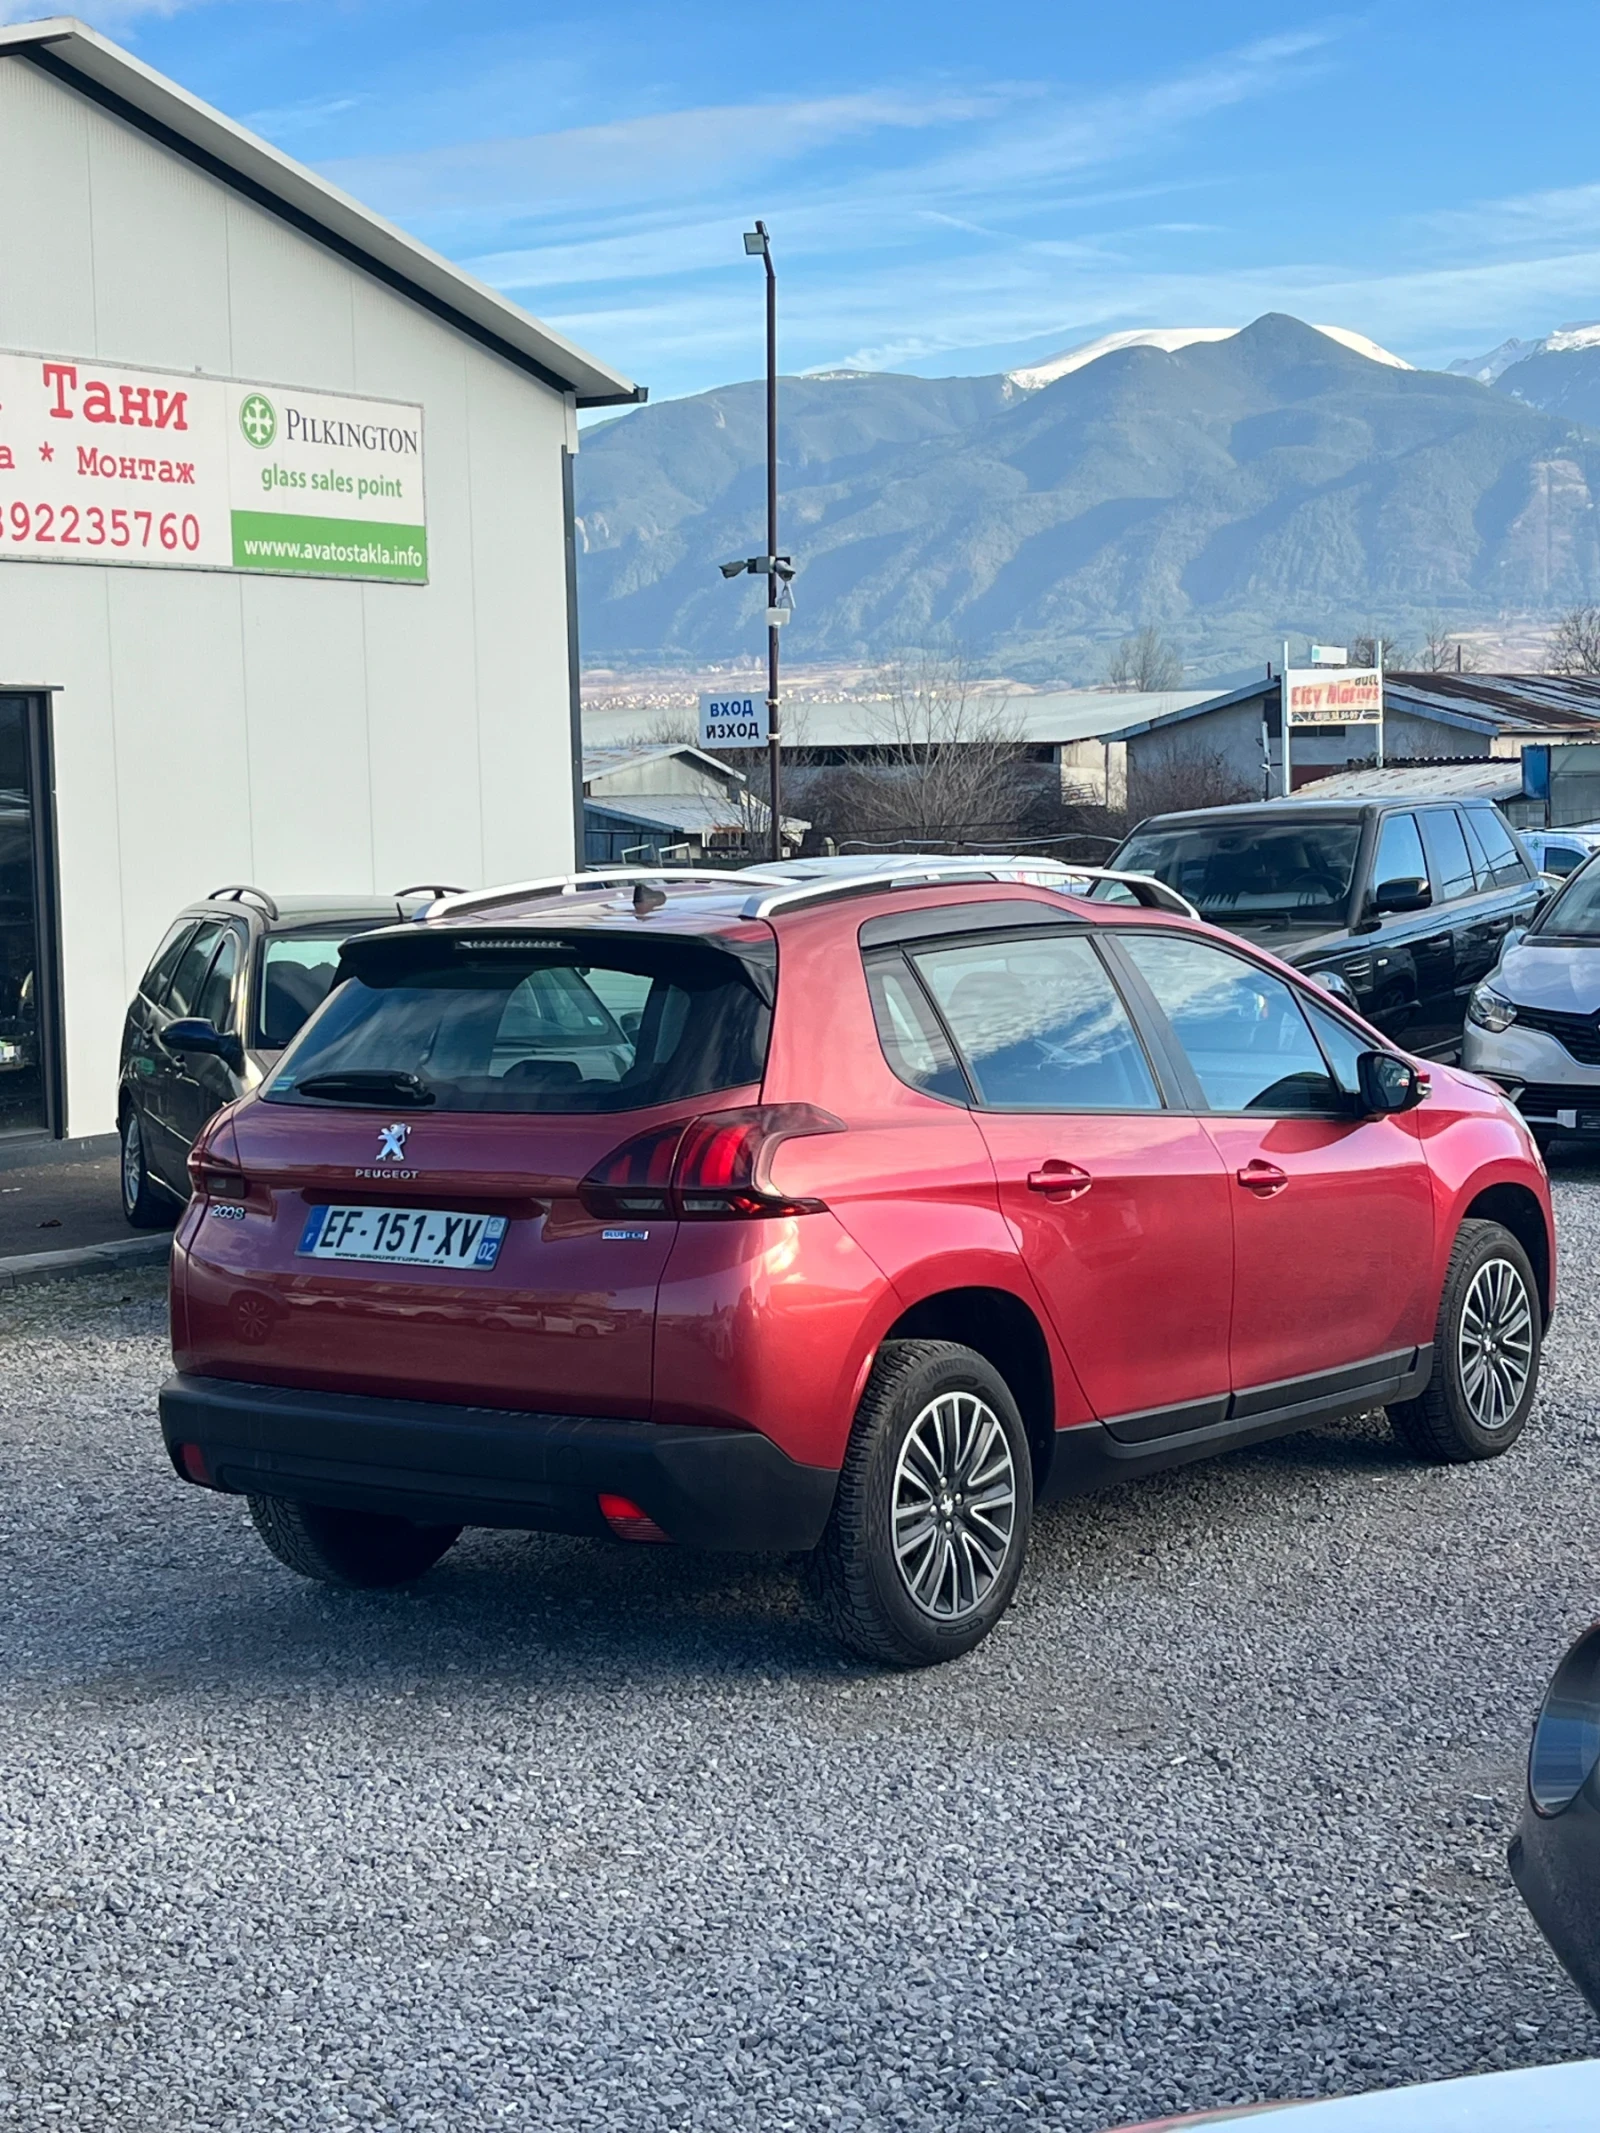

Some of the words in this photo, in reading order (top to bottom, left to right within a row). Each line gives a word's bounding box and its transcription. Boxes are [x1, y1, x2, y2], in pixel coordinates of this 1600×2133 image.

[42, 363, 188, 431] Тани
[285, 408, 418, 455] PILKINGTON
[76, 446, 196, 485] Монтаж
[261, 463, 307, 491] glass
[311, 469, 354, 494] sales
[358, 475, 403, 500] point
[0, 501, 200, 551] 92235760
[710, 699, 754, 718] ВХОД
[706, 722, 760, 740] ИЗХОД
[355, 1168, 419, 1179] PEUGEOT
[211, 1204, 245, 1220] 2008
[319, 1210, 483, 1257] EF-151-XV
[477, 1242, 499, 1261] 02
